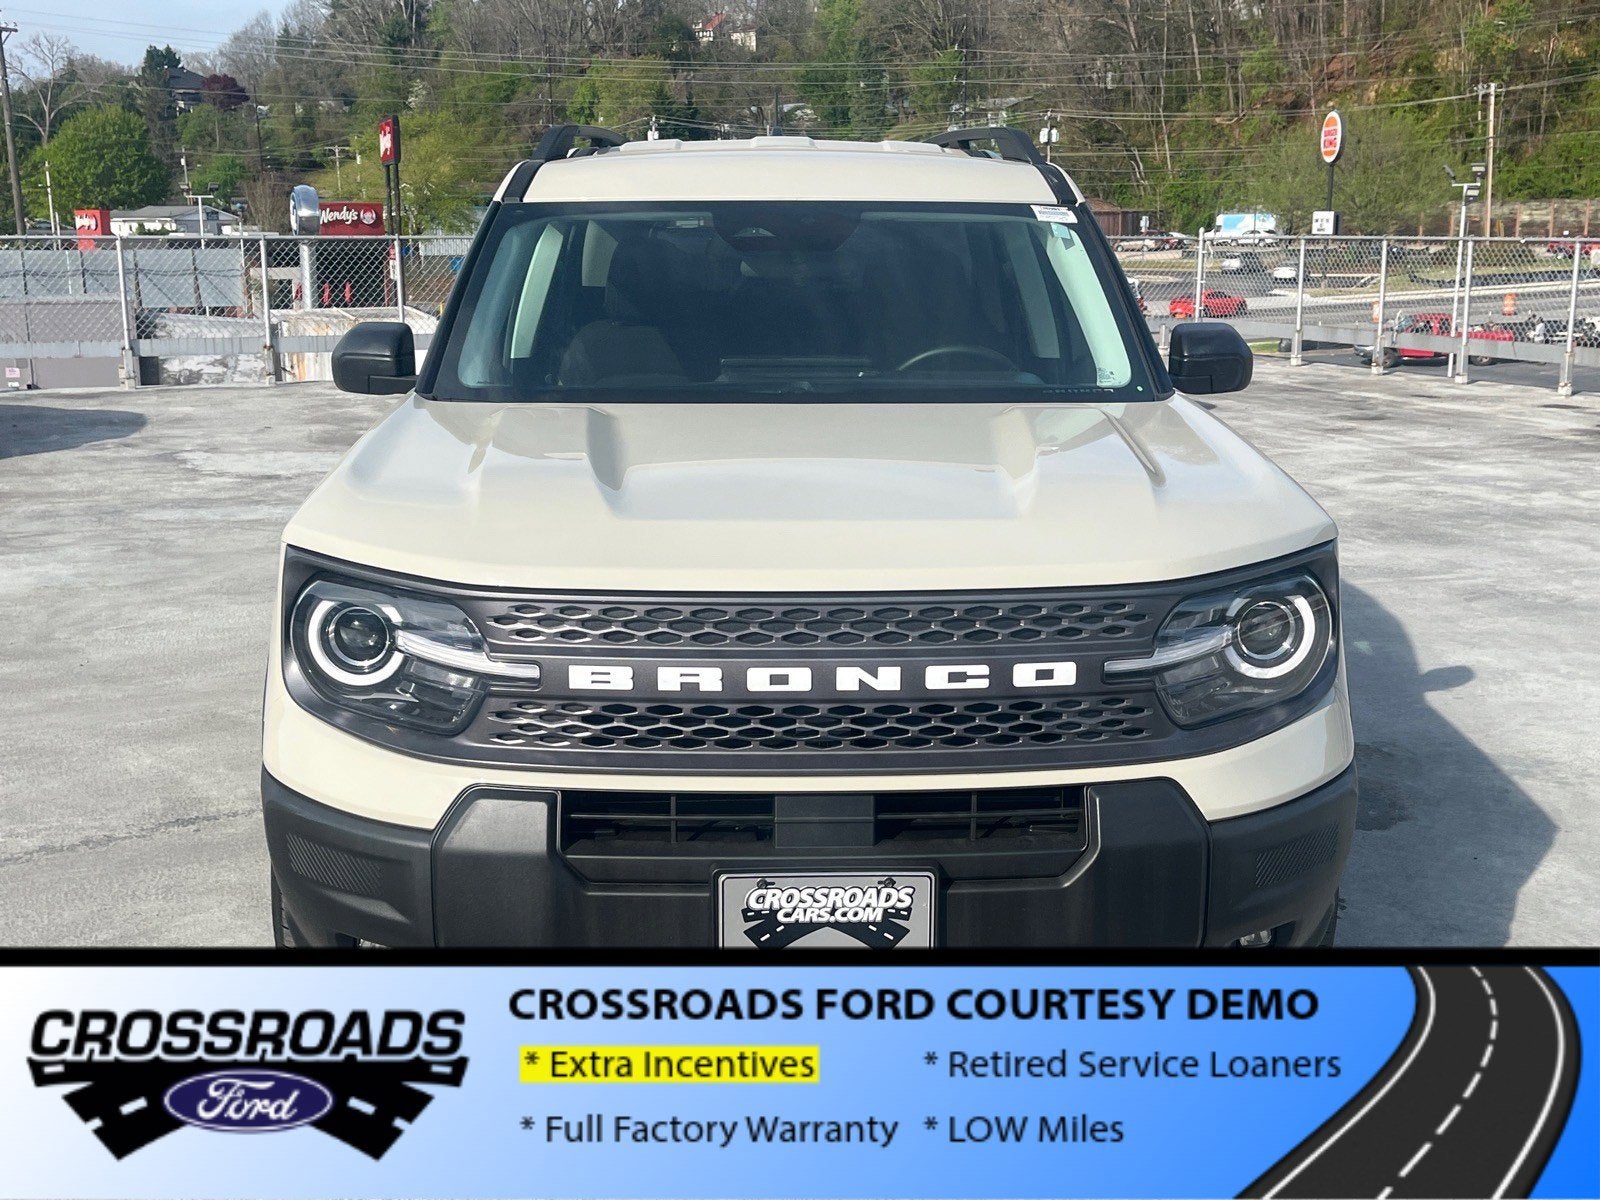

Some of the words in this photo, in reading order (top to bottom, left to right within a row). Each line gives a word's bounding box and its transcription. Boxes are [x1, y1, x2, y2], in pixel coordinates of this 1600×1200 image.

[319, 206, 359, 225] Wendy's
[568, 661, 1077, 692] BRONCO
[746, 885, 915, 910] CROSSROADS
[776, 907, 885, 924] CARS.COM
